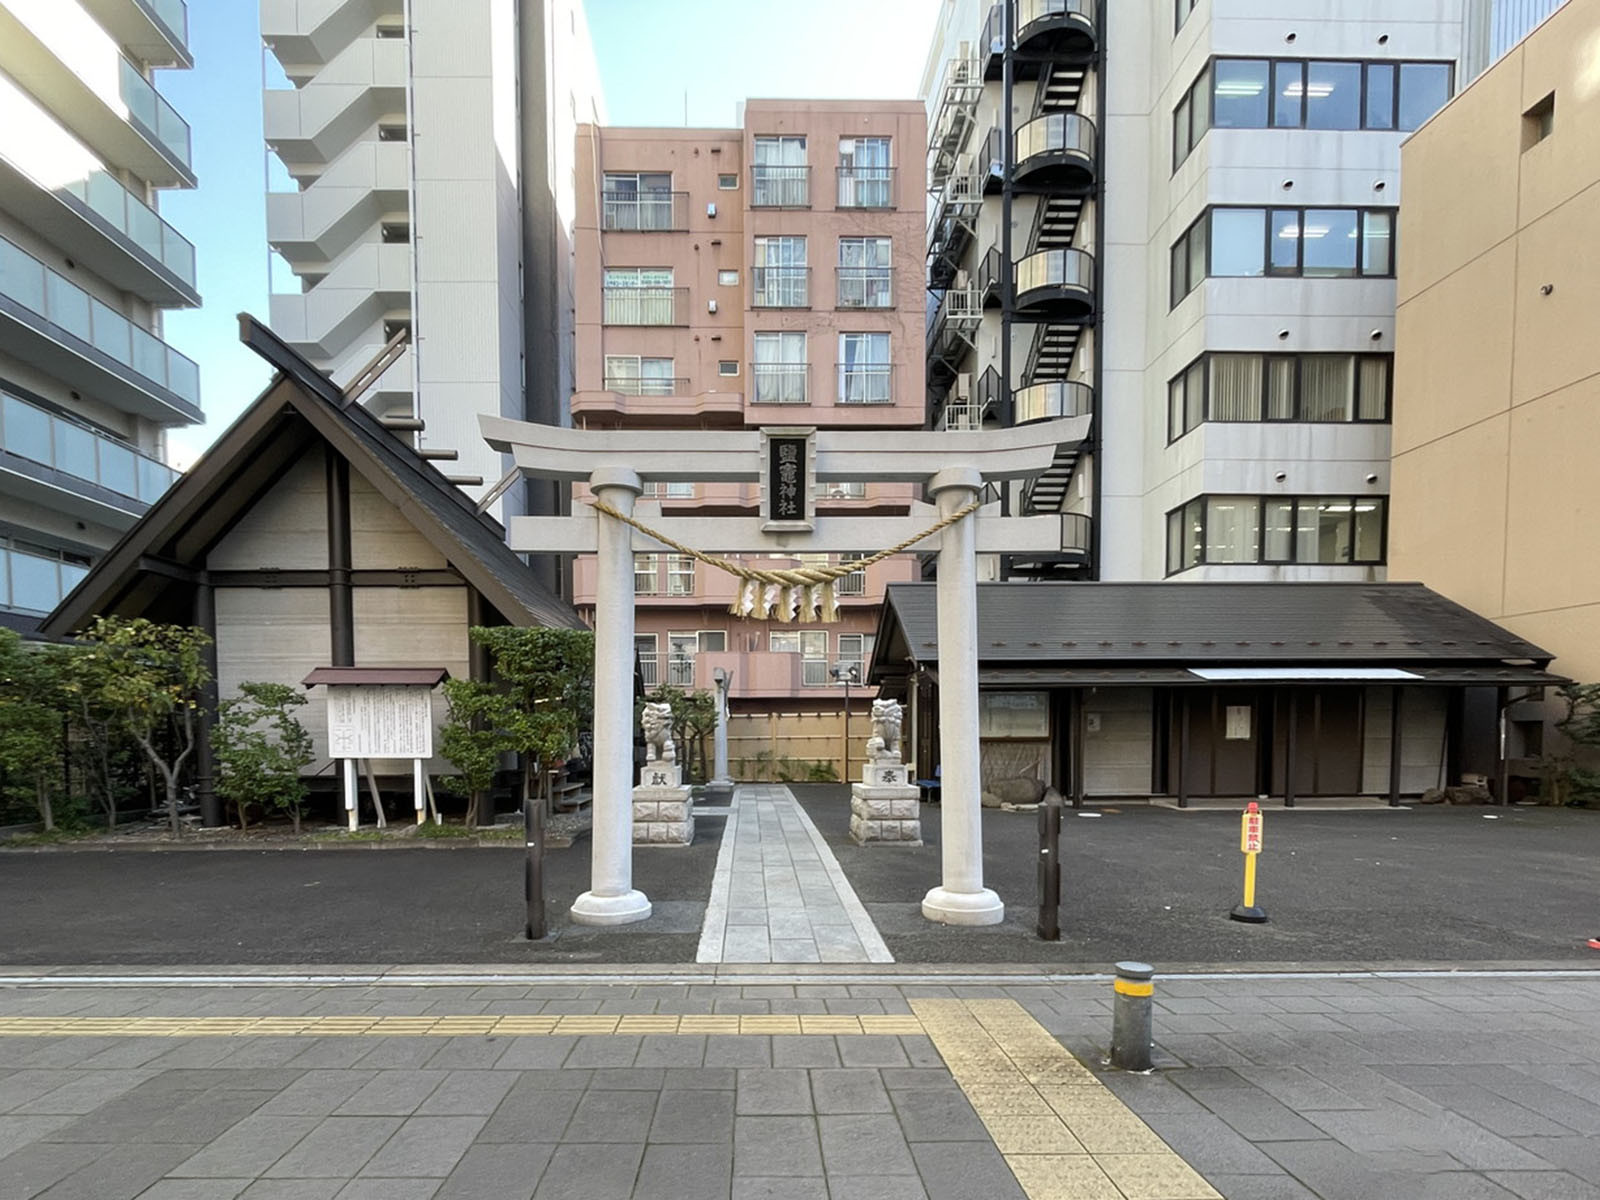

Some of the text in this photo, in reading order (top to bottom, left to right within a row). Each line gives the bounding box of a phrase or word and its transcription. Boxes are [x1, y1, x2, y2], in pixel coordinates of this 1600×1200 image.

[881, 769, 897, 784] 奉
[1248, 817, 1260, 851] 駐車禁止
